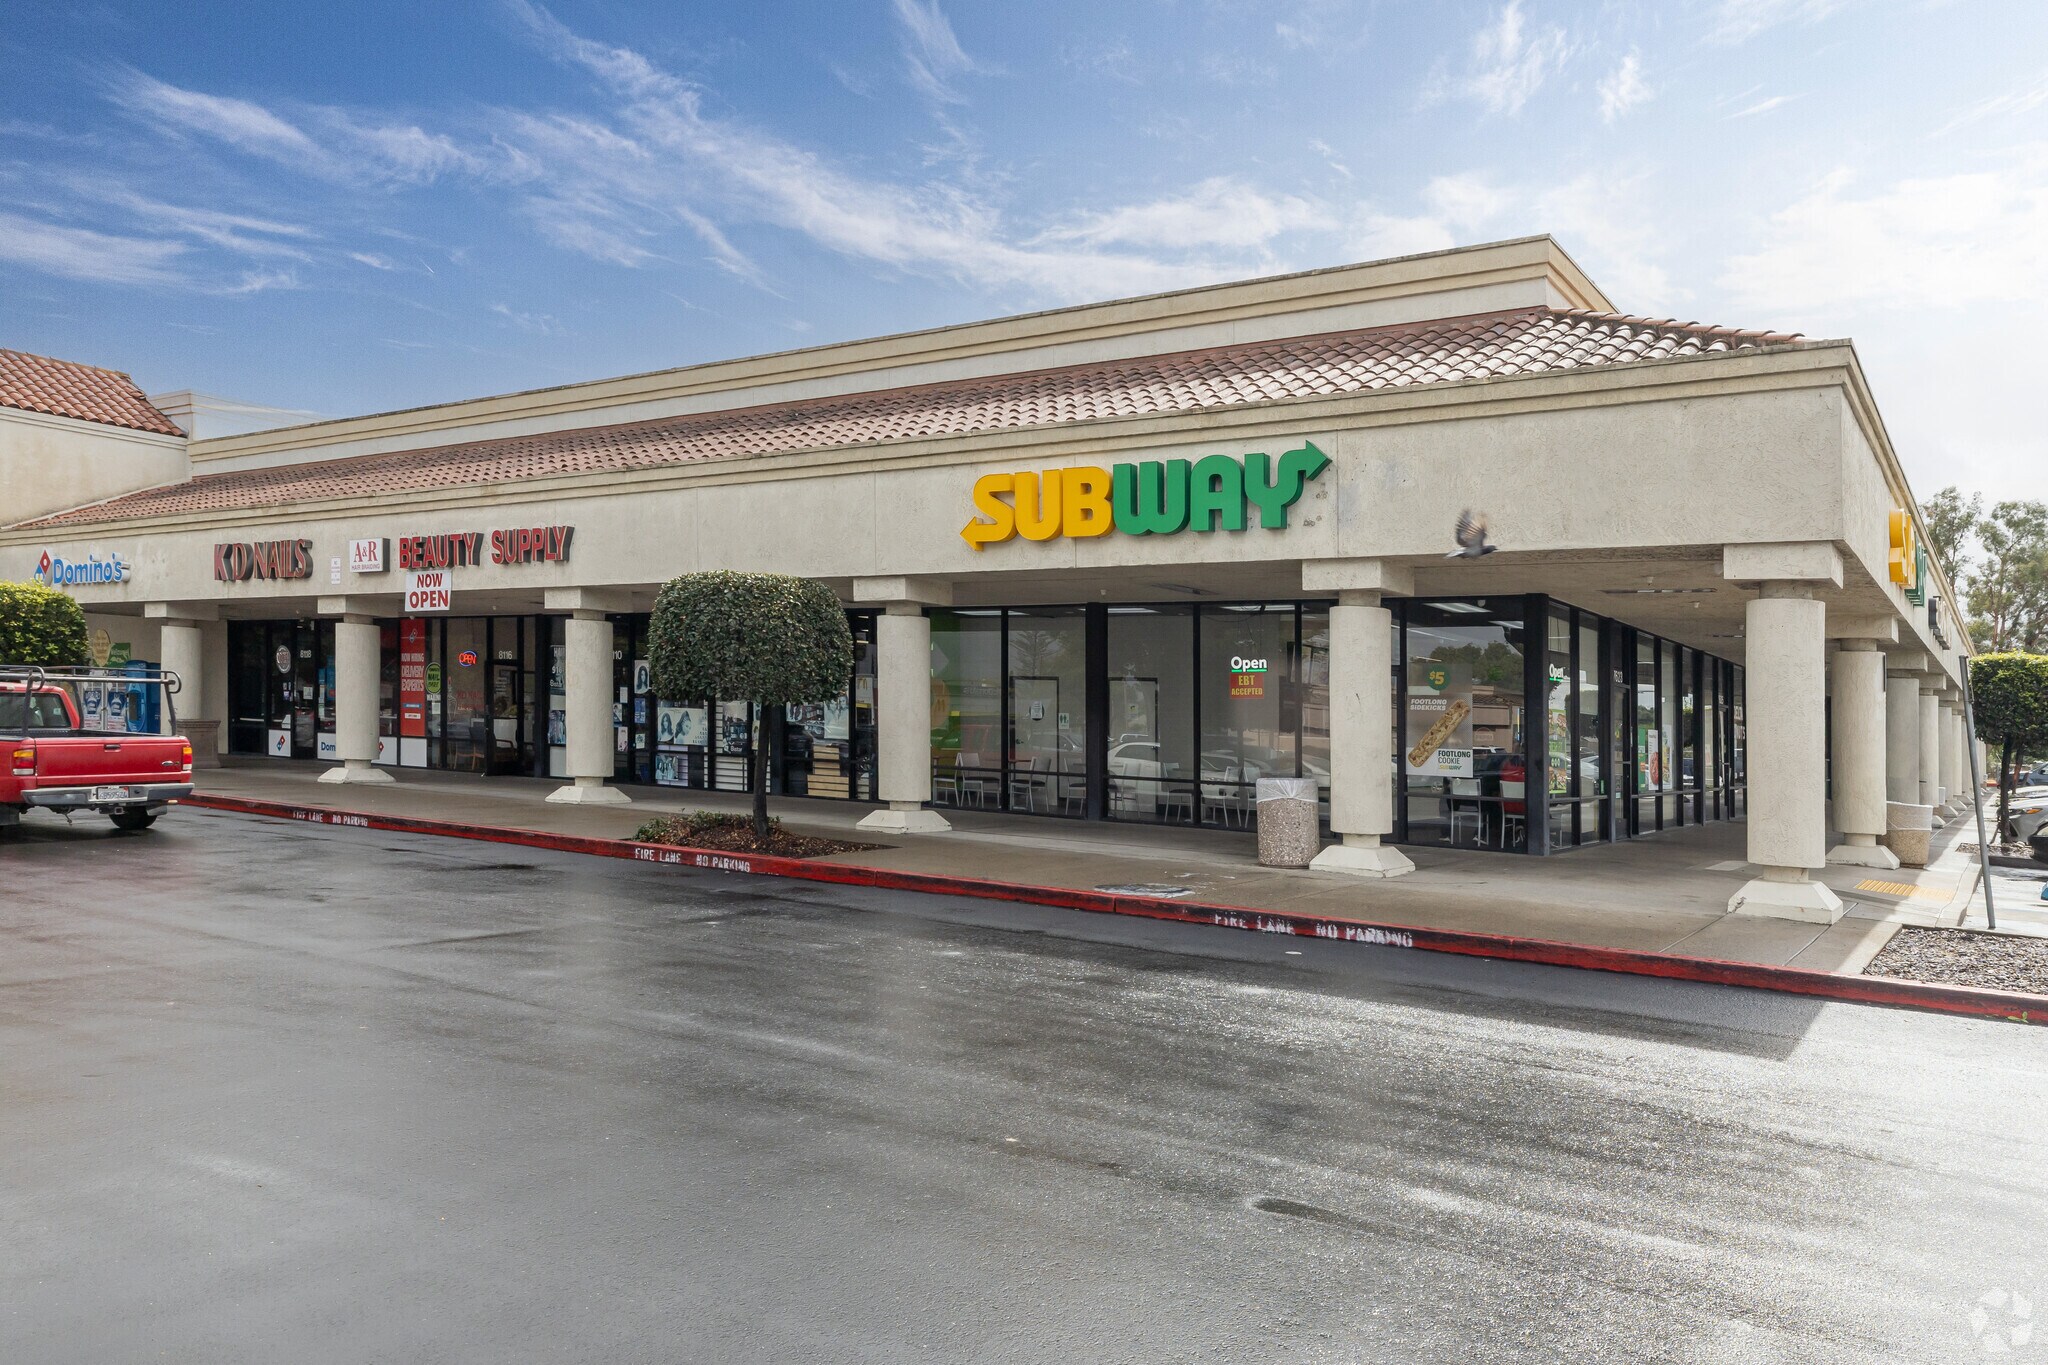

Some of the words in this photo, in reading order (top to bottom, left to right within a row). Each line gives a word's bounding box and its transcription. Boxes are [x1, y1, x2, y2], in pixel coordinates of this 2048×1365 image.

[959, 440, 1332, 551] SUBWAY
[353, 541, 378, 563] A&R
[399, 532, 482, 569] BEAUTY
[491, 526, 573, 564] SUPPLY
[214, 543, 250, 581] KD
[253, 539, 310, 579] NAILS
[53, 552, 125, 585] Domino's
[417, 573, 443, 588] NOW
[409, 590, 449, 609] OPEN
[458, 652, 477, 665] OPEN
[498, 651, 513, 660] 8116
[612, 650, 623, 660] 110
[401, 665, 425, 678] DELIVERY
[1230, 655, 1268, 673] Open
[1429, 670, 1445, 685] $5
[1549, 664, 1564, 681] Open
[401, 678, 425, 692] EXPERTS
[1238, 675, 1255, 686] EBT
[1231, 688, 1263, 696] ACCEPTED
[1438, 750, 1471, 758] FOOTLONG
[308, 812, 324, 823] LANE
[332, 814, 342, 824] NO
[635, 847, 655, 861] FIRE
[659, 851, 681, 864] LANE
[696, 854, 709, 867] NO
[712, 856, 750, 873] PARKING
[1214, 911, 1248, 929] FIRE
[1256, 915, 1296, 935] LANE
[1316, 922, 1338, 938] NO
[1346, 926, 1413, 947] PARKING
